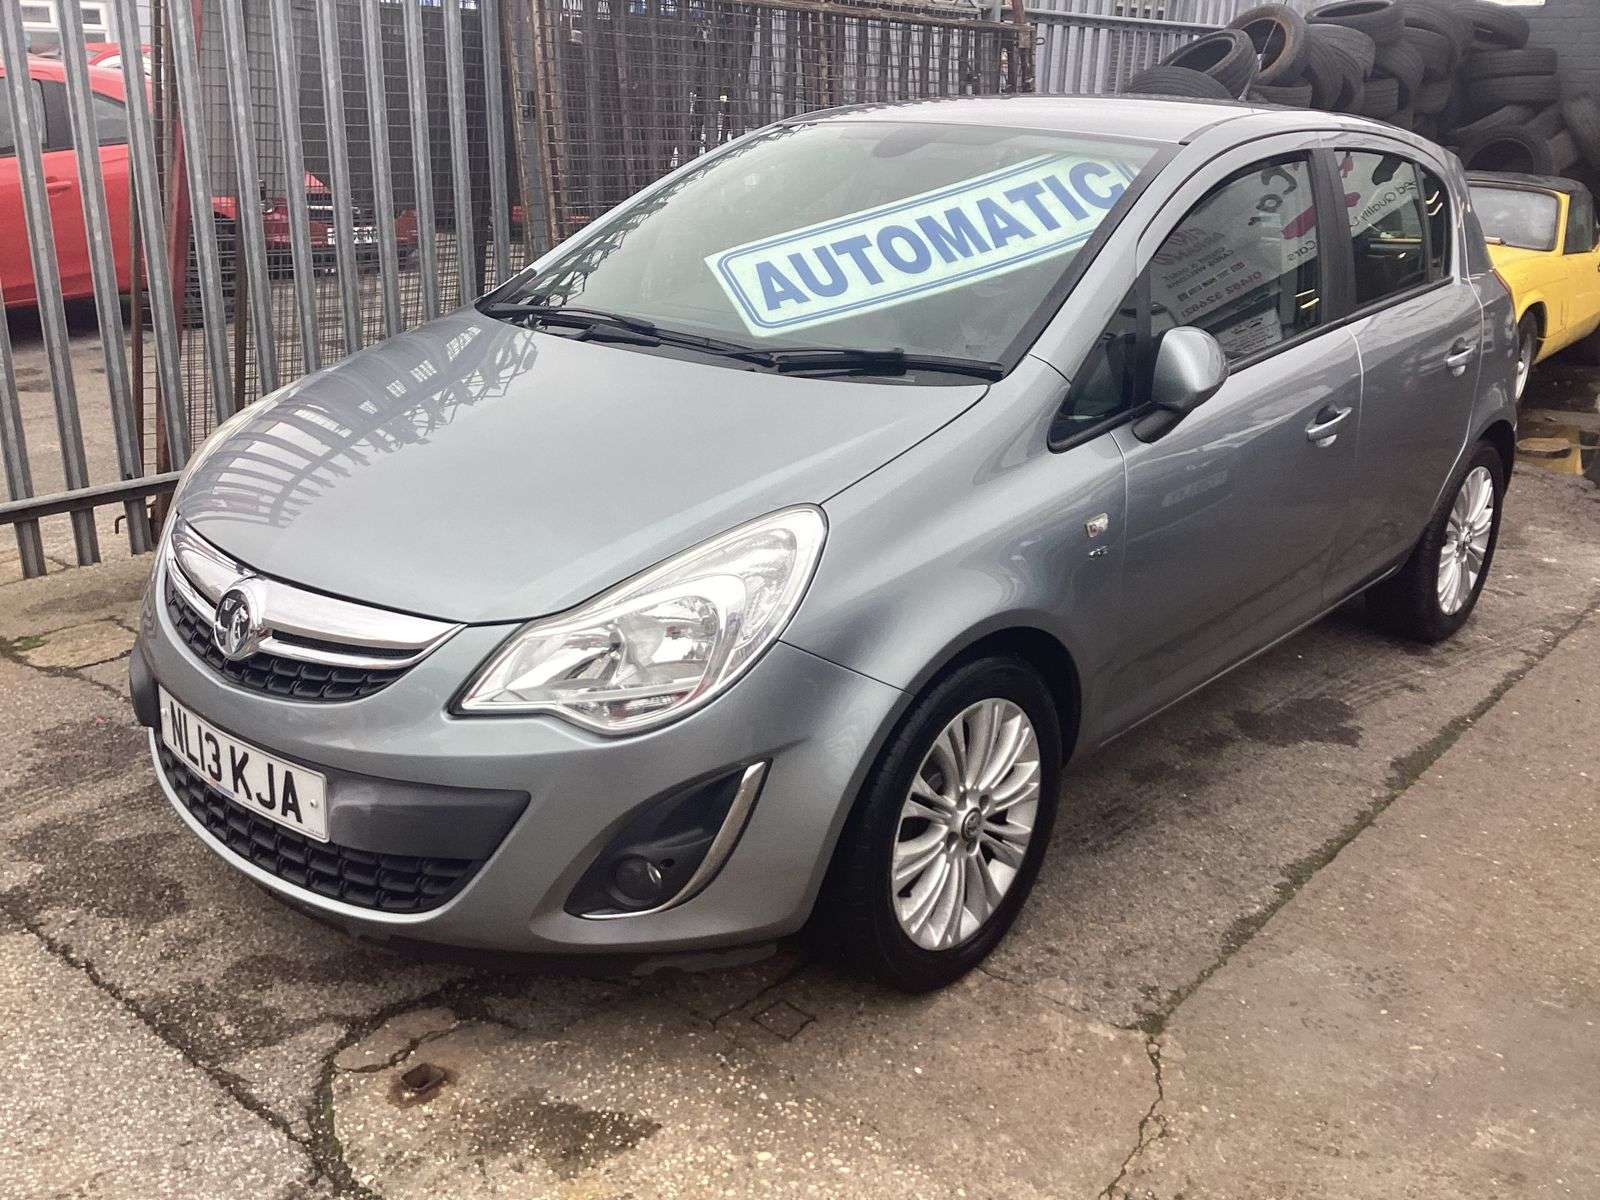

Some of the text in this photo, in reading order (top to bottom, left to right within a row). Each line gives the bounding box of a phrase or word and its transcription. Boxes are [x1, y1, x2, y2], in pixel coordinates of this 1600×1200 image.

[755, 161, 1125, 311] AUTOMATIC
[170, 701, 303, 823] NL13 KJA
